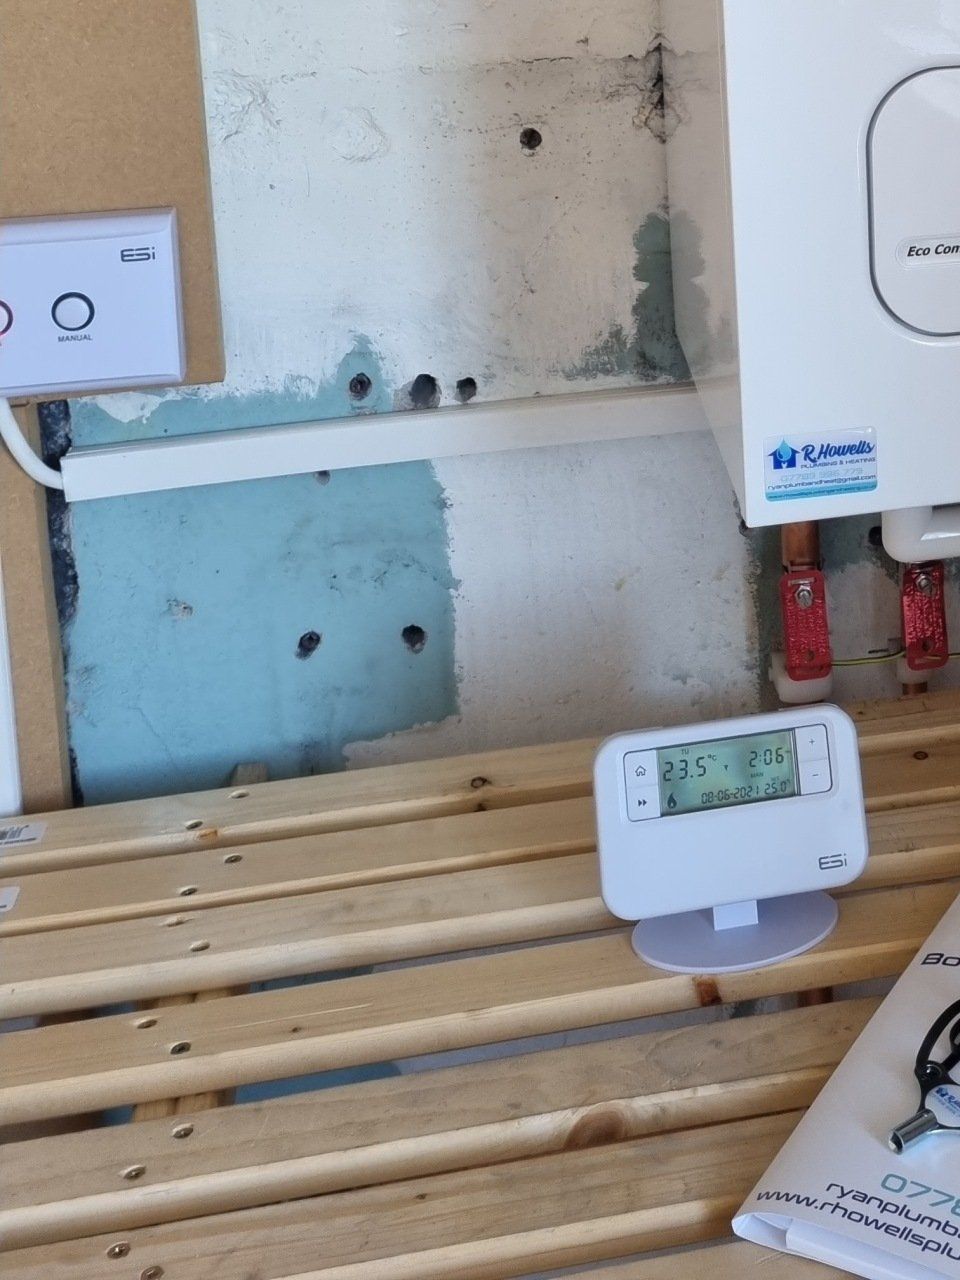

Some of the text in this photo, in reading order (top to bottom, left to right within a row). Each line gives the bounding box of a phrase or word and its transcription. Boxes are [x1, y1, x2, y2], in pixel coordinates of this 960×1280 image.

[907, 246, 931, 257] Eco
[57, 333, 93, 343] MANUAL
[800, 439, 875, 463] R.Howells
[749, 747, 785, 768] 2:06
[701, 784, 760, 805] 08-06-2021
